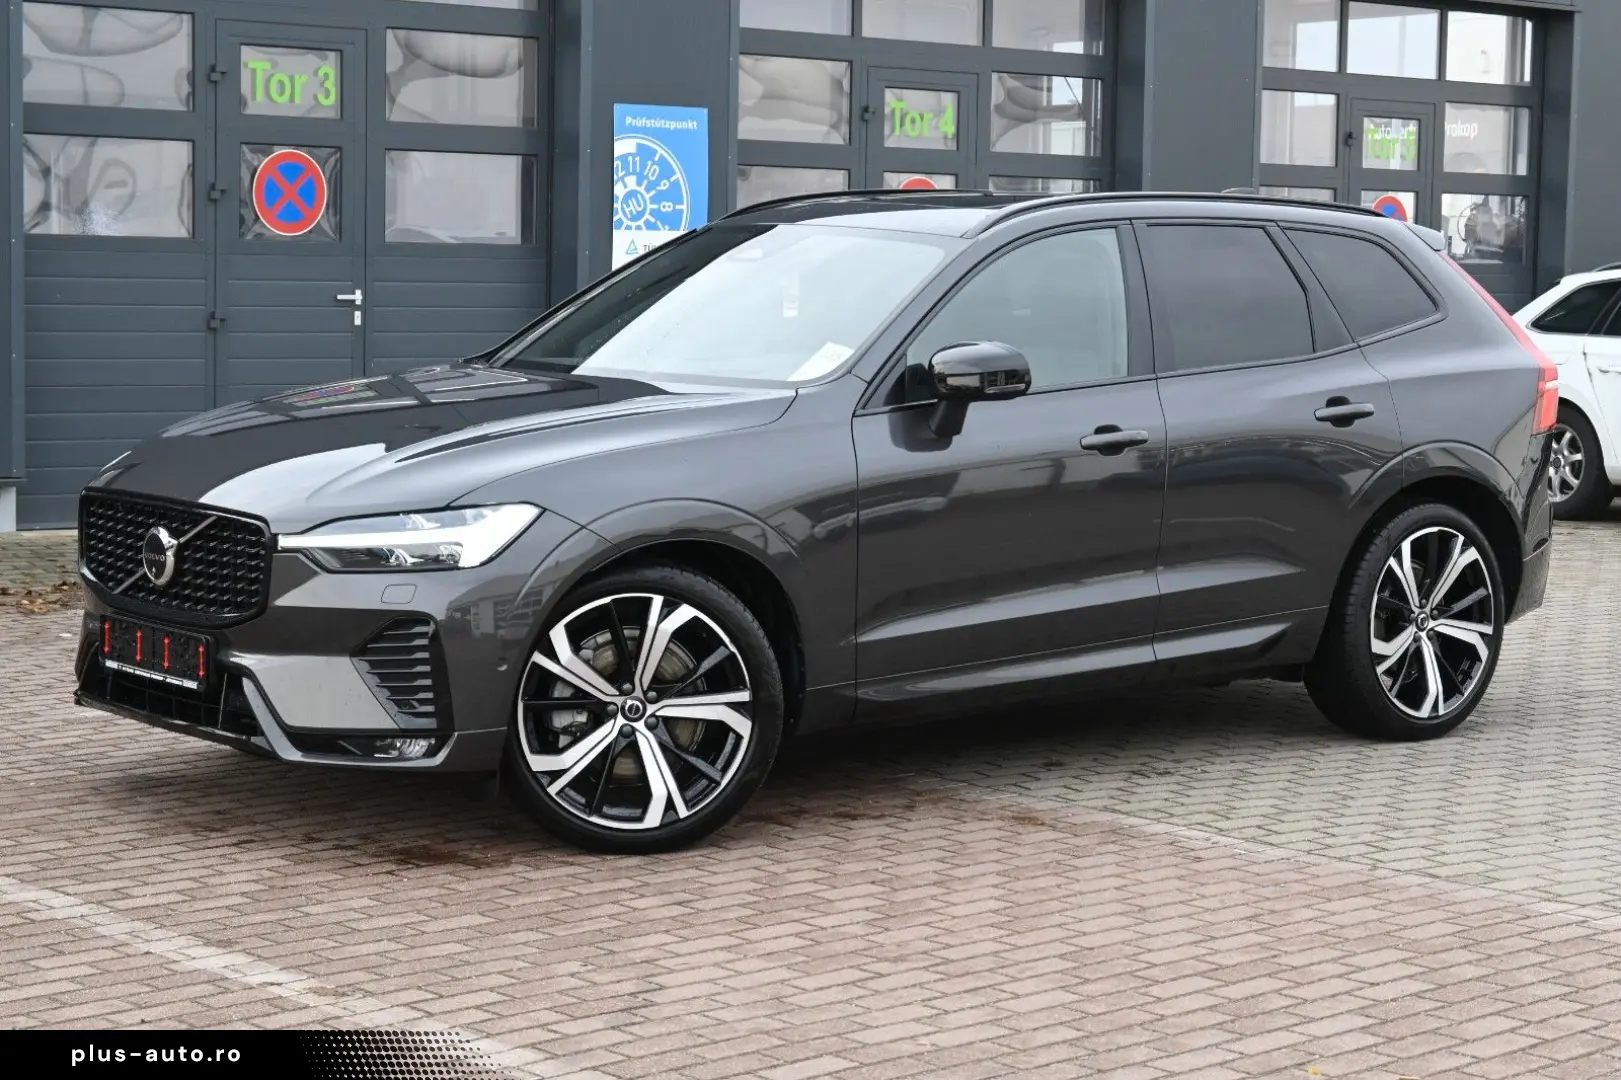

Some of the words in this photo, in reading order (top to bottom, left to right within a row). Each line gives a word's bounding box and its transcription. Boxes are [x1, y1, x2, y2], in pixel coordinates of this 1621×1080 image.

[247, 60, 309, 104] Tor
[317, 65, 336, 106] 3
[625, 115, 698, 131] Prüfstützpunkt
[889, 100, 934, 137] Tor
[939, 105, 955, 139] 4
[1444, 120, 1478, 140] rokop
[627, 156, 640, 173] 11
[644, 160, 660, 181] 10
[623, 194, 644, 218] HU
[660, 201, 673, 213] 8
